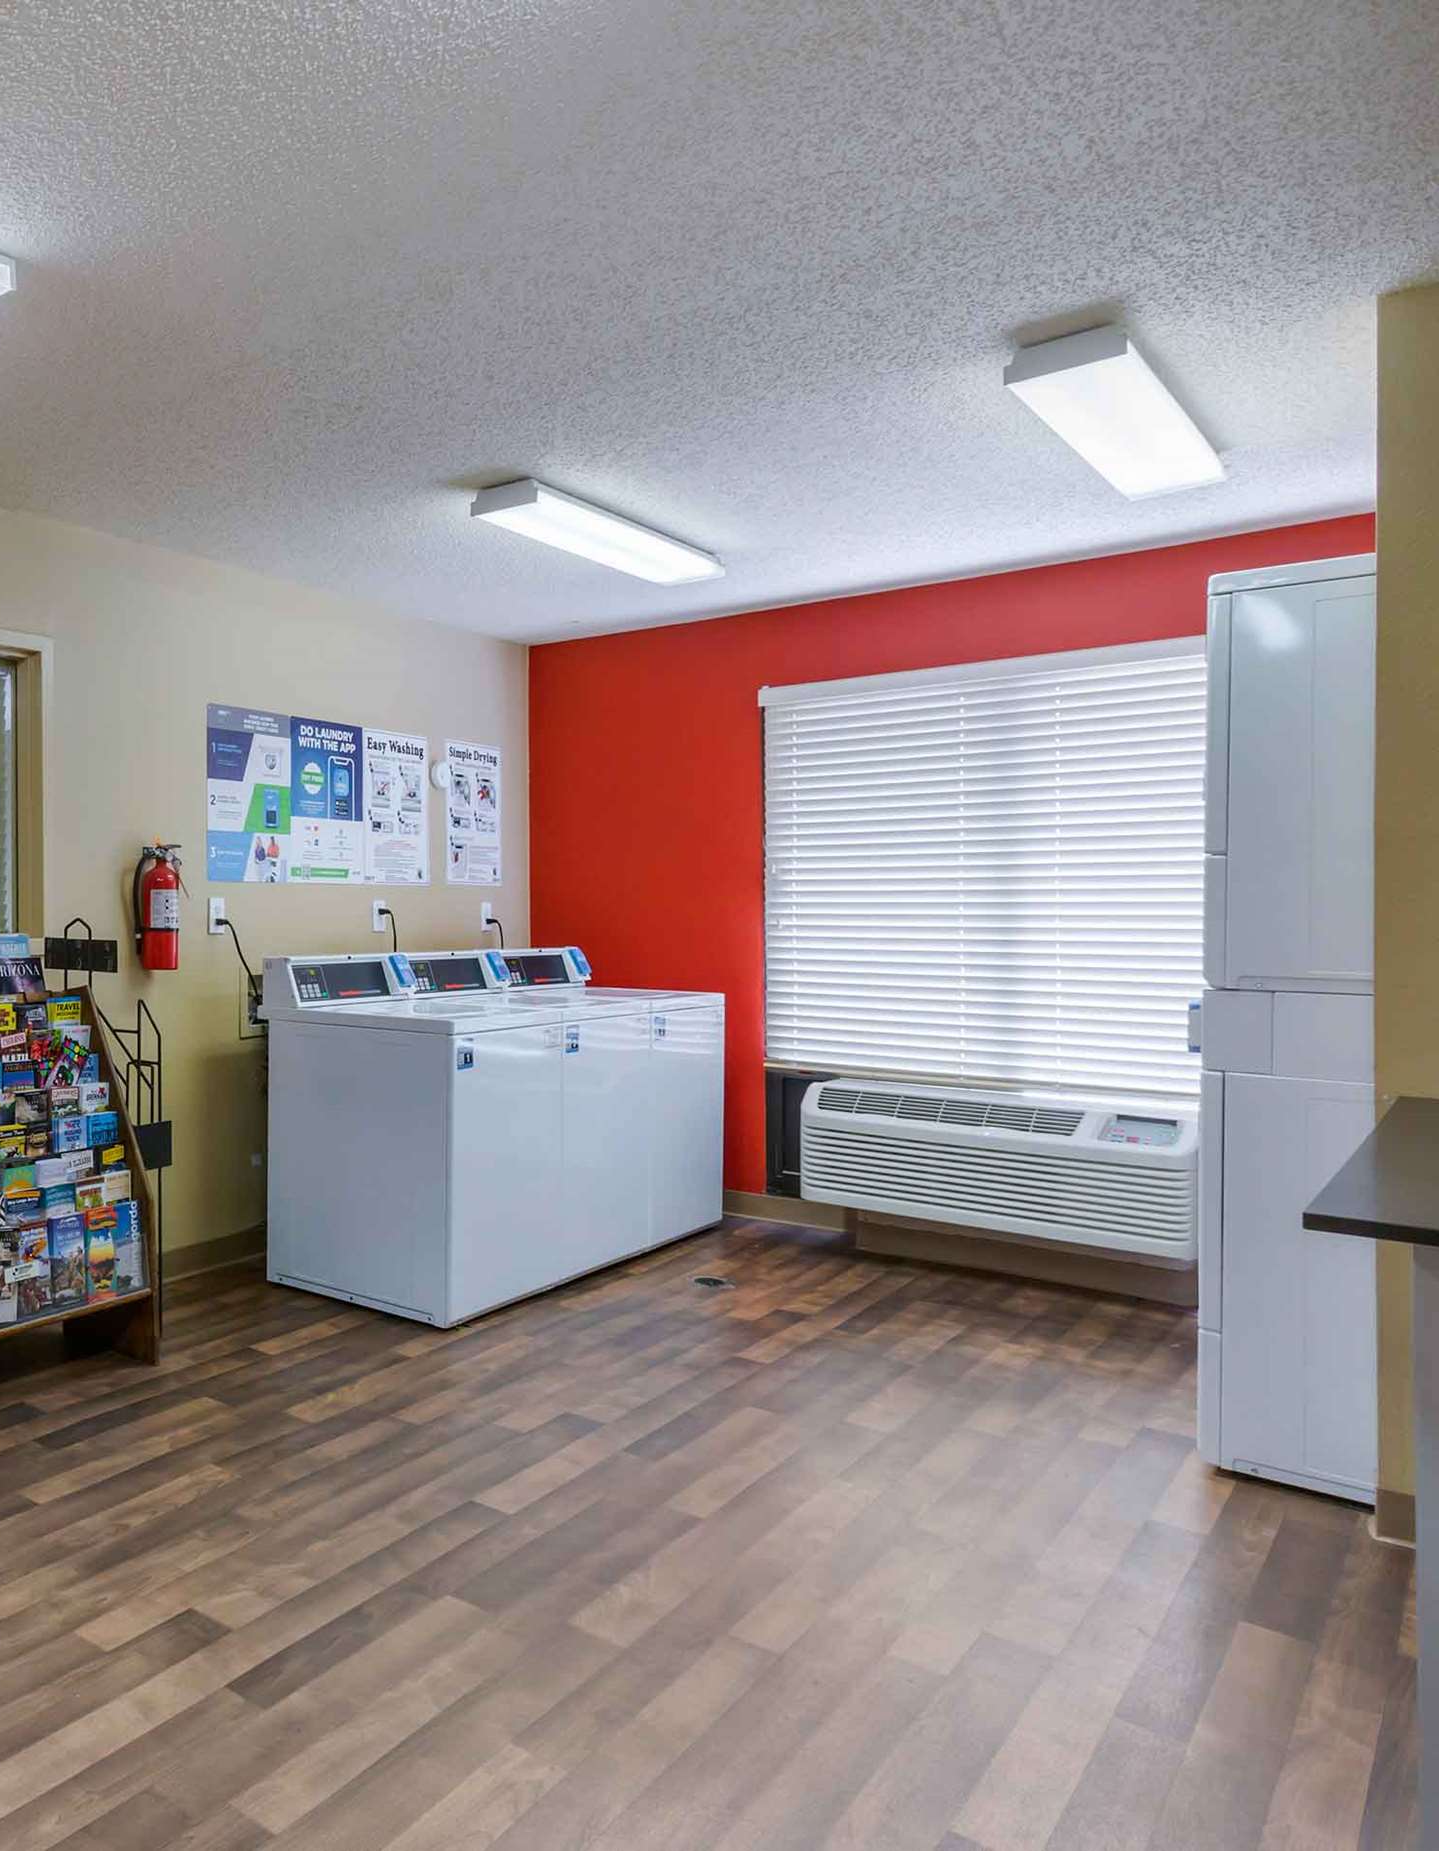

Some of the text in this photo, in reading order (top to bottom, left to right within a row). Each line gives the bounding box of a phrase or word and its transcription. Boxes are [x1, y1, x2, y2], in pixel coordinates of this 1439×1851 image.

[300, 725, 354, 742] DO LAUNDRY
[298, 735, 356, 754] WITH THE APP
[367, 736, 387, 754] Easy
[388, 740, 425, 760] Washing
[448, 746, 473, 763] Simple
[474, 750, 498, 767] Drying
[210, 794, 216, 806] 2
[57, 1002, 80, 1012] TRAVEL
